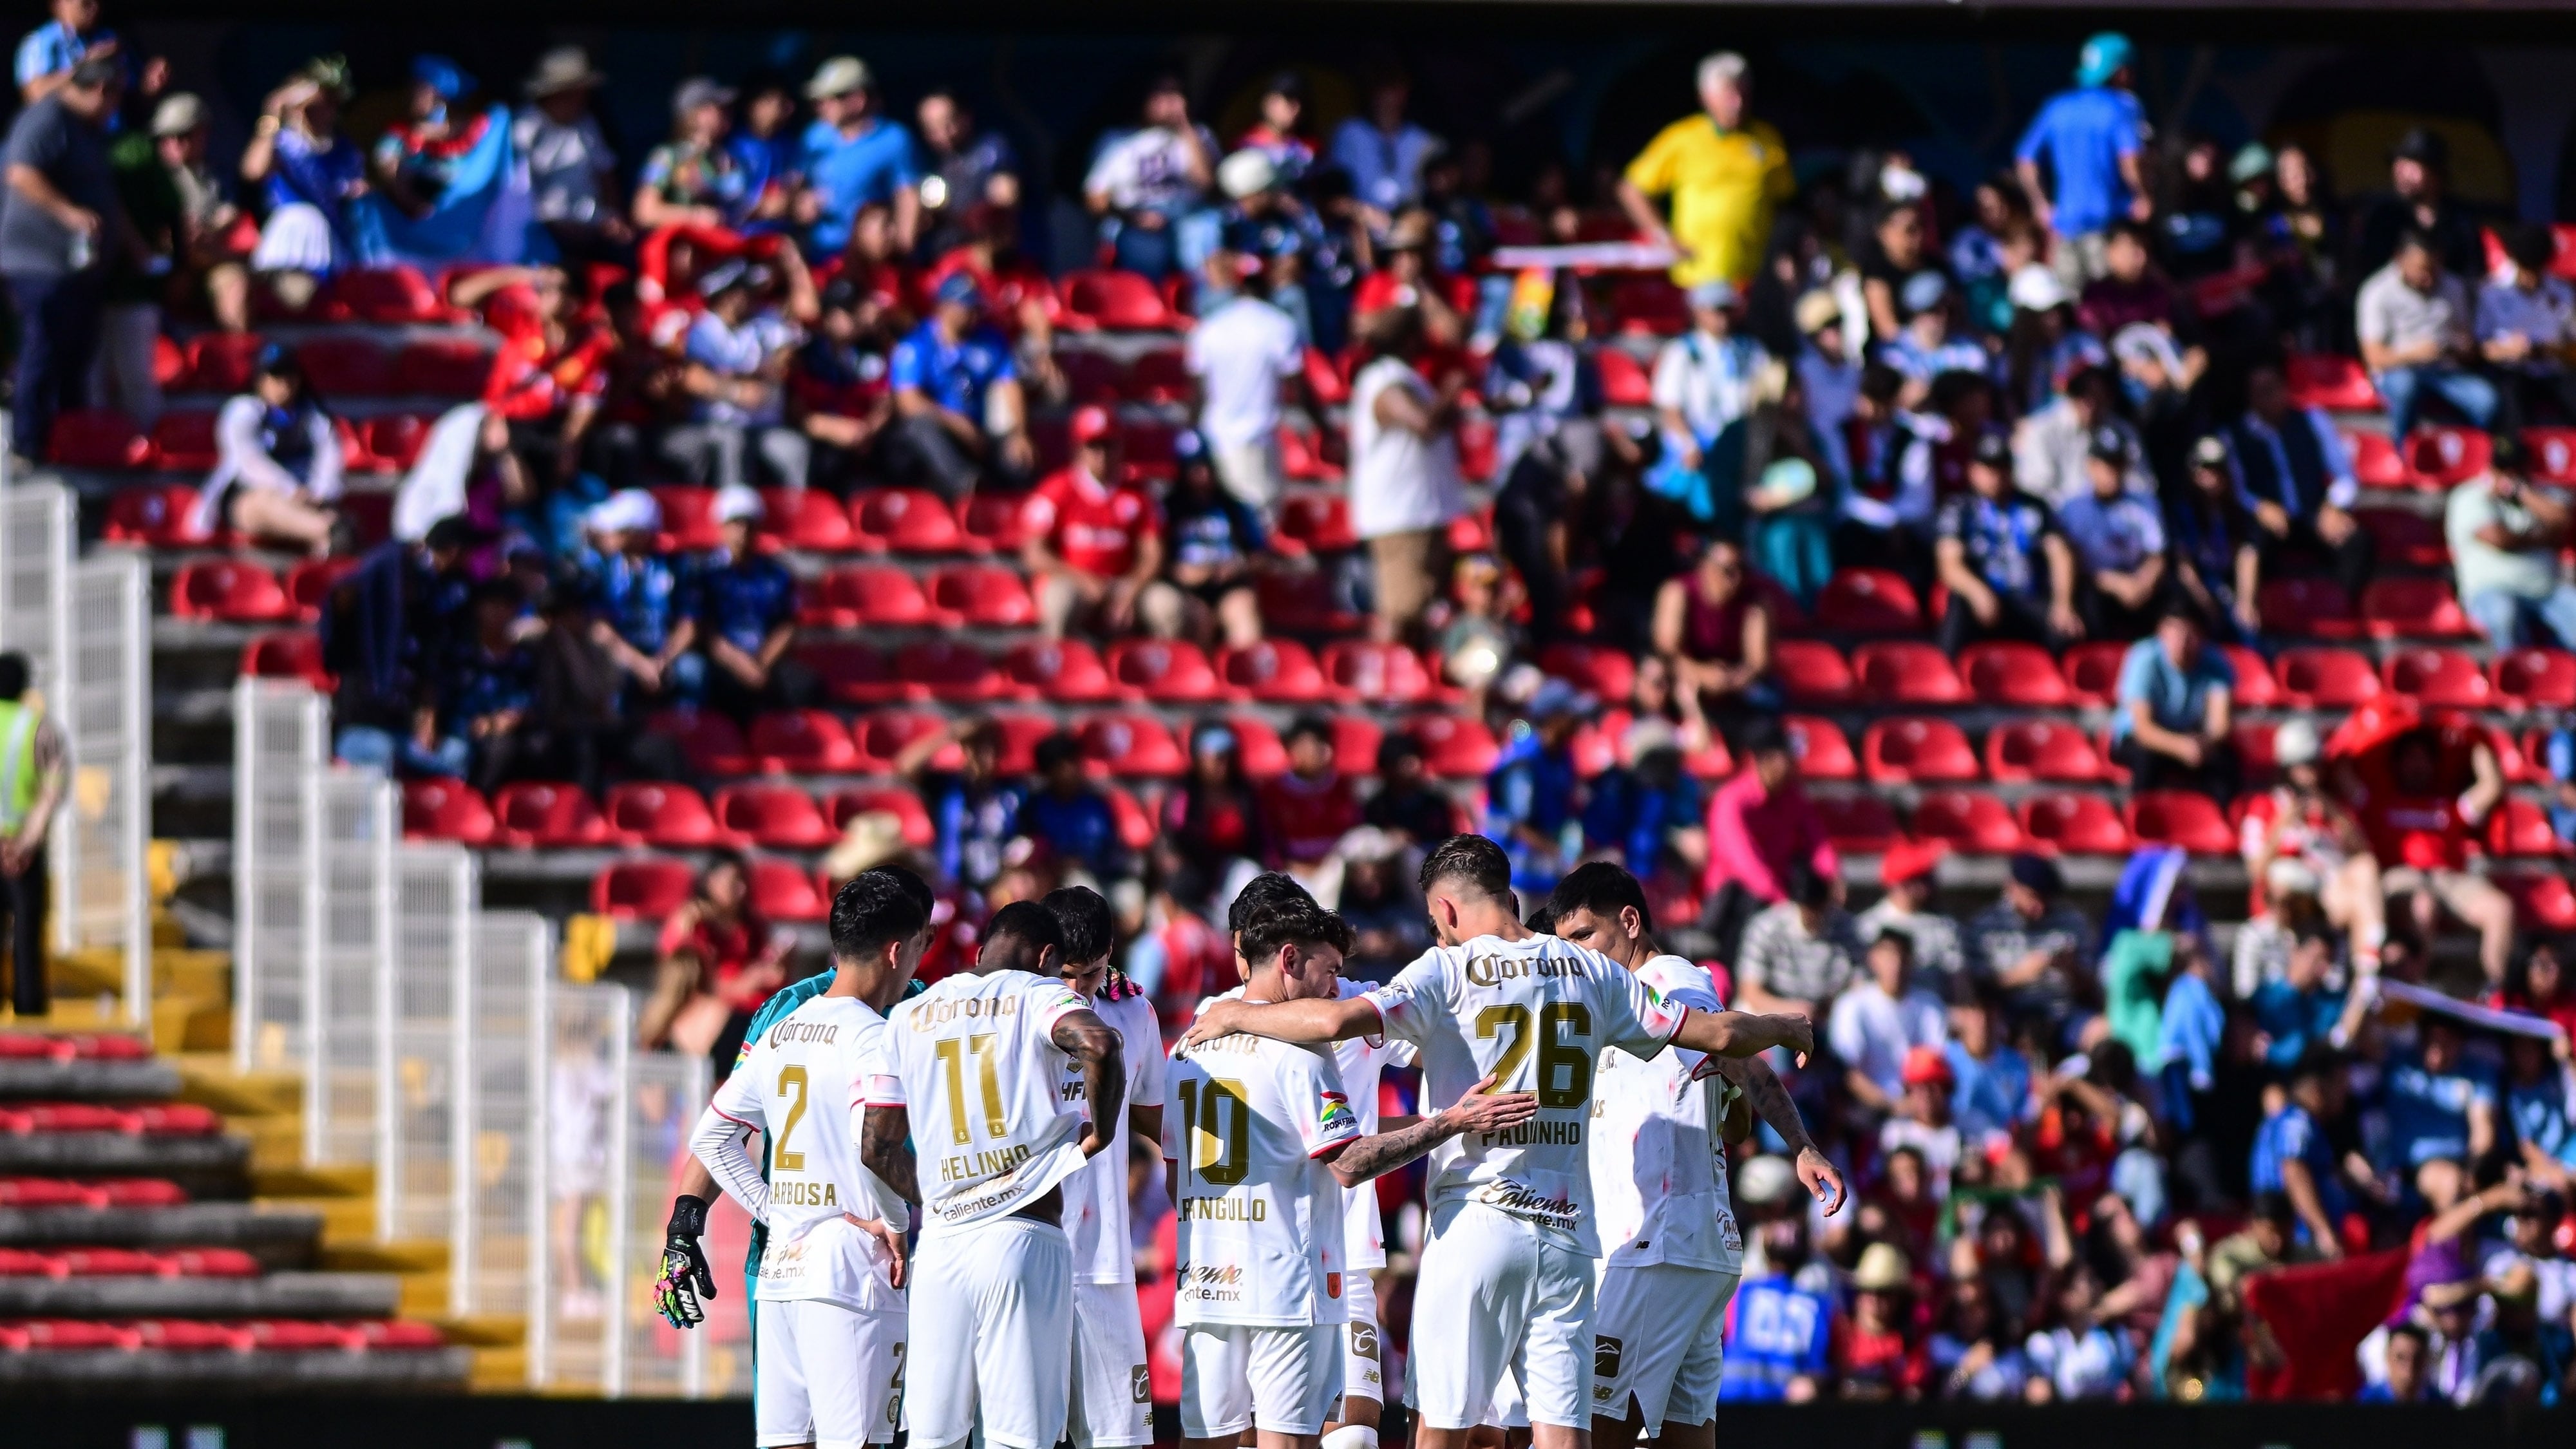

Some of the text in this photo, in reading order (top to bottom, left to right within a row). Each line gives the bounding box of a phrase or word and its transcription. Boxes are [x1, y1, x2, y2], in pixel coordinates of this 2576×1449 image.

[1466, 952, 1586, 990] Corona
[910, 994, 1016, 1033] Corona
[770, 1015, 839, 1052] Corona
[1475, 1001, 1591, 1109] 26
[936, 1032, 1007, 1145] 11
[775, 1064, 809, 1171] 2
[1179, 1077, 1250, 1186] 10
[941, 1144, 1032, 1182] HELINHO
[943, 1185, 1027, 1222] caliente.mx
[1480, 1179, 1580, 1215] Caliente
